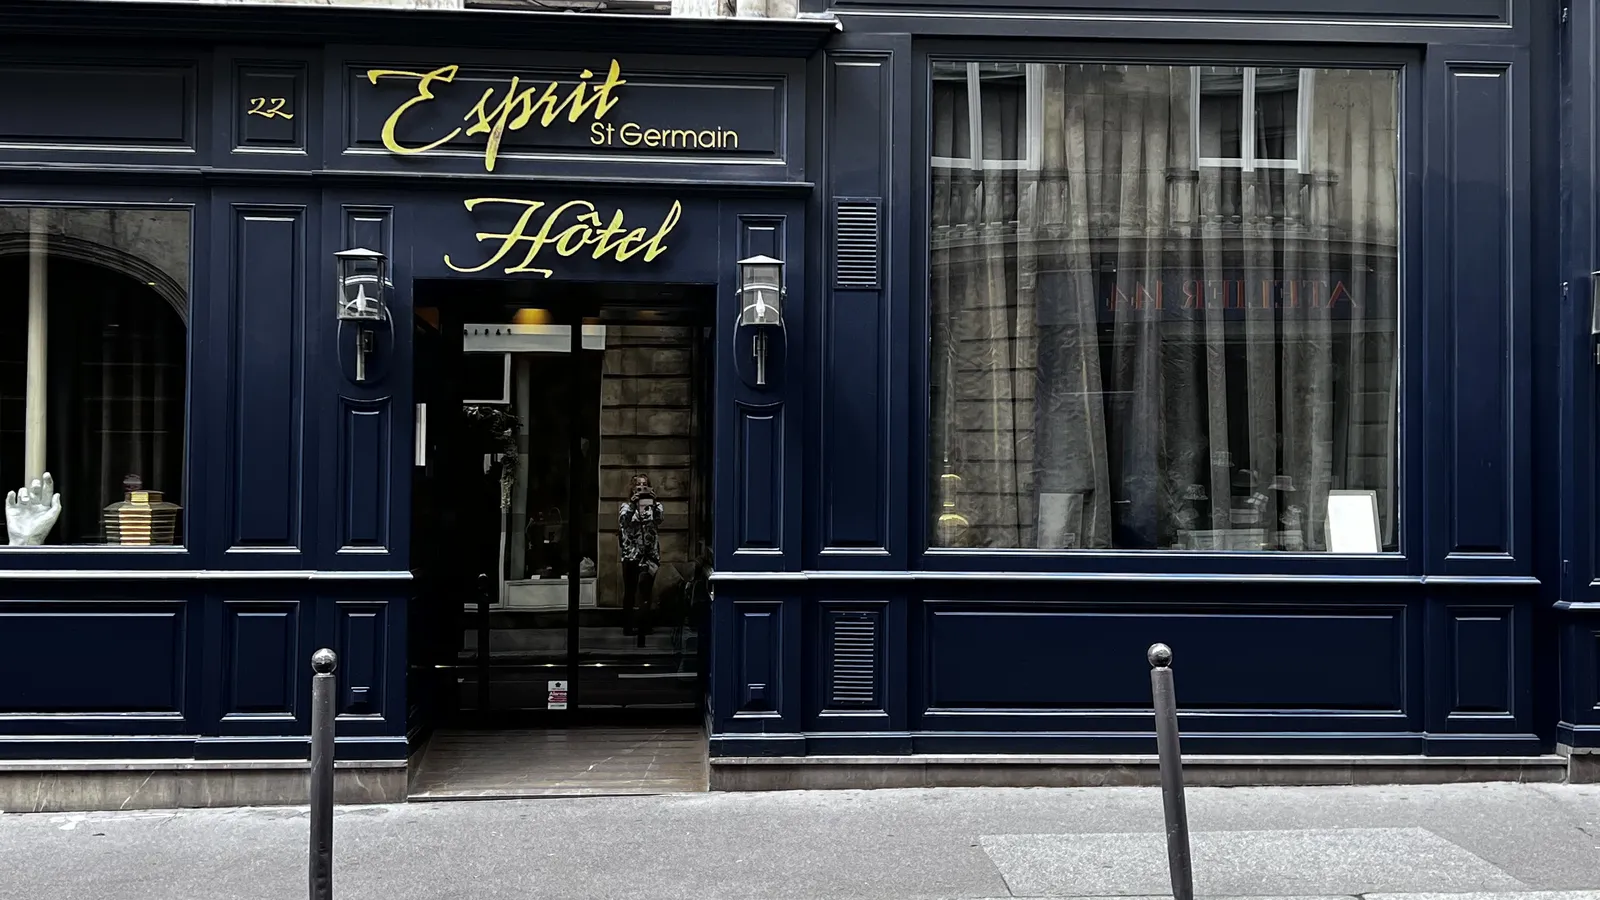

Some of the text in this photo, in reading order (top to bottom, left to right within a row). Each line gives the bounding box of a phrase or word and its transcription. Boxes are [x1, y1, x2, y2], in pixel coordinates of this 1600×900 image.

[248, 97, 294, 119] 22
[368, 58, 627, 171] Esprit
[590, 122, 738, 150] St Germain
[444, 198, 682, 278] Hôtel
